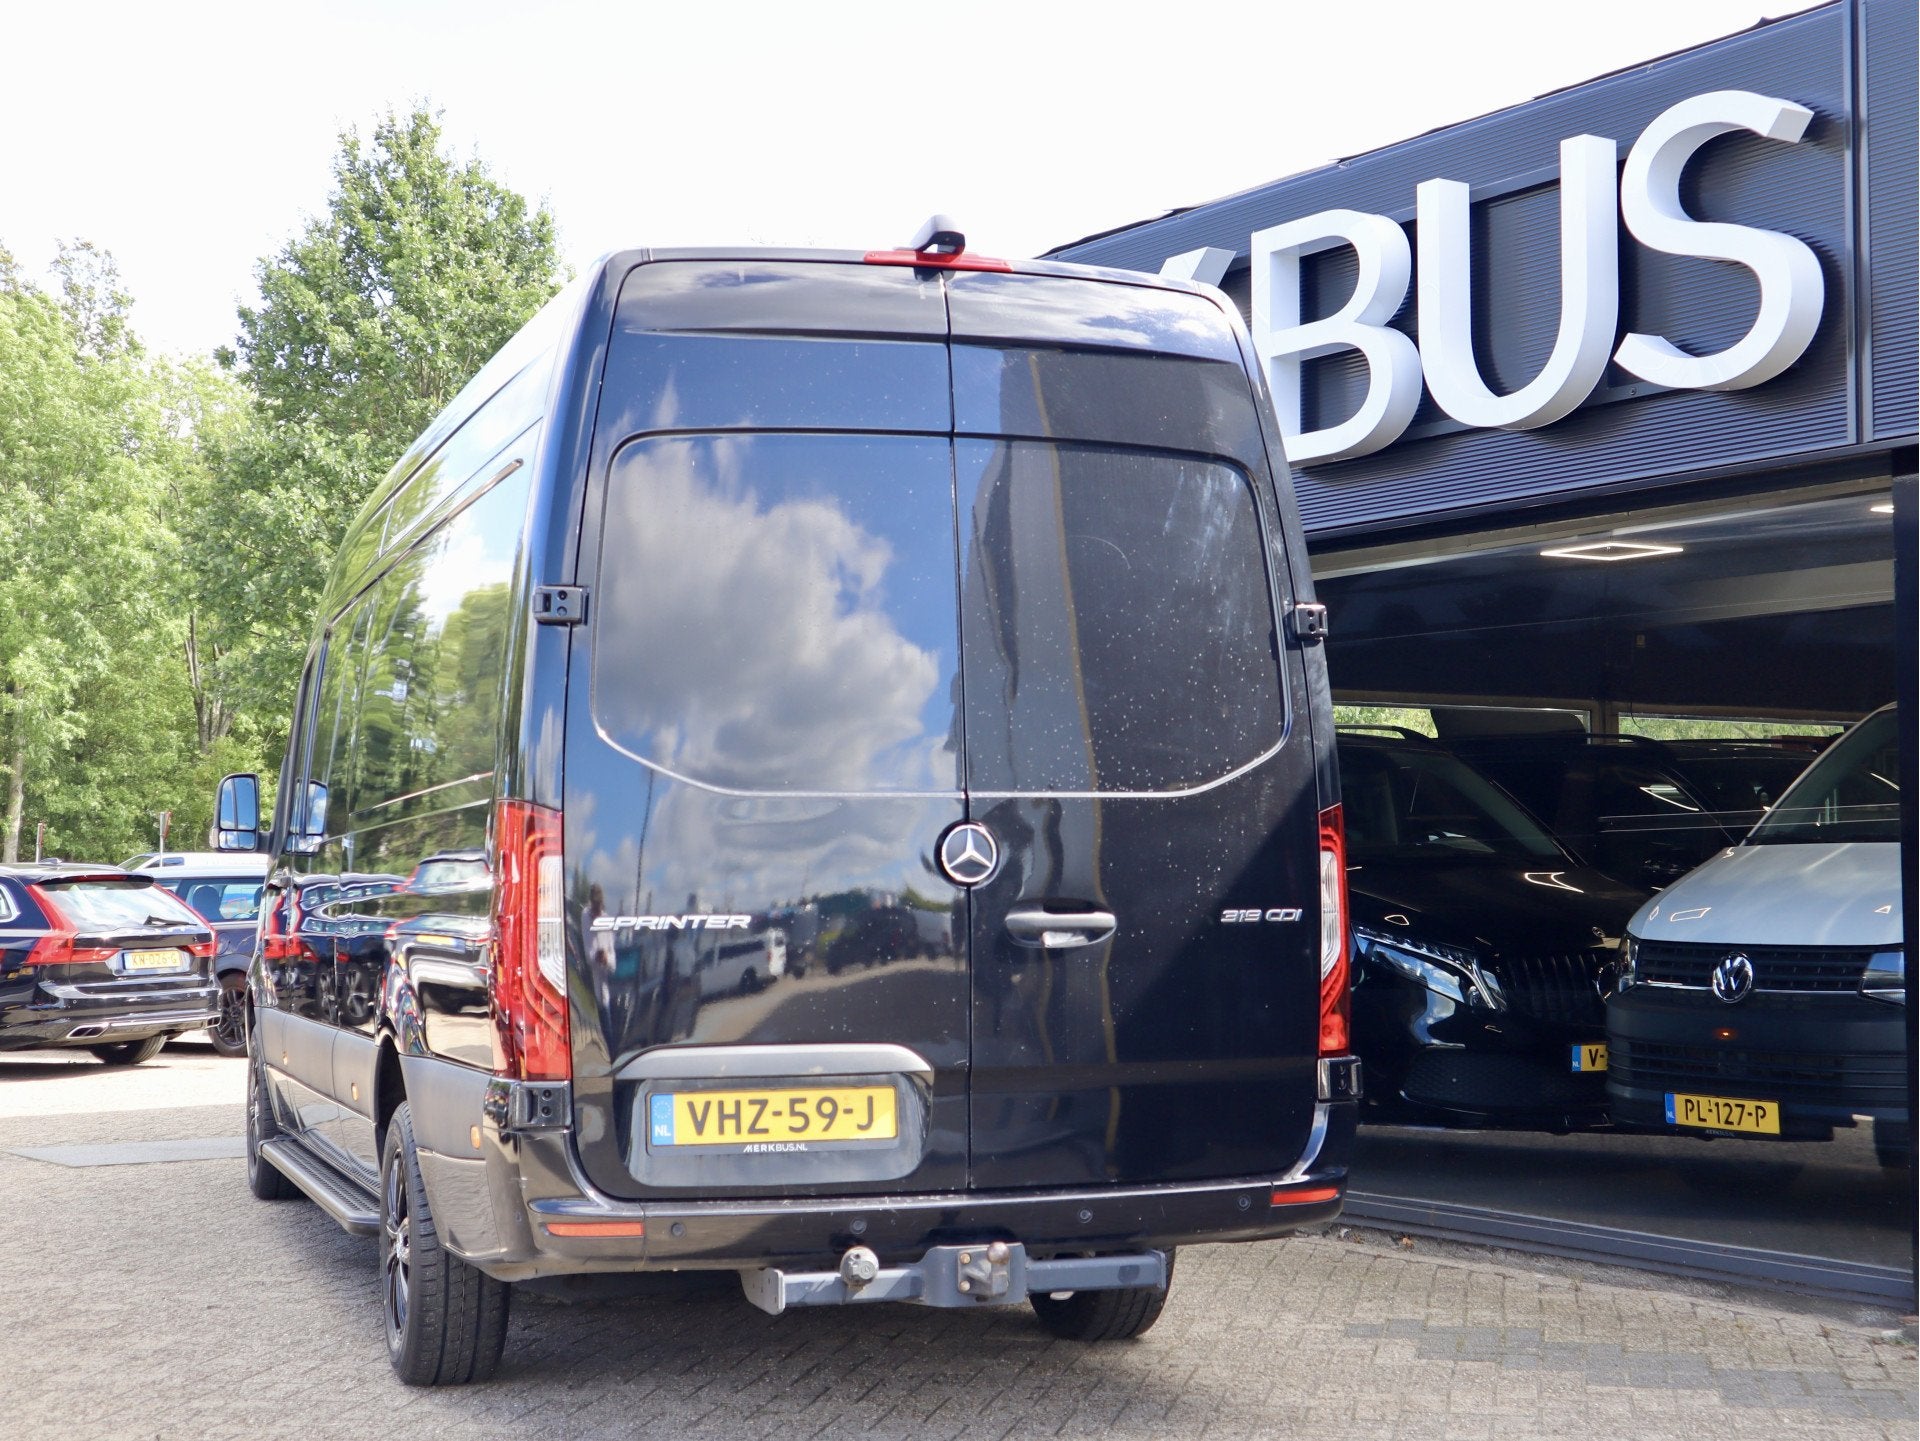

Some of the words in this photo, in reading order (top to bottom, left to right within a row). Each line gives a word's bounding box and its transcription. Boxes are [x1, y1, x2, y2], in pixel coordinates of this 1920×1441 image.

[1157, 89, 1826, 463] BUS
[590, 914, 752, 931] SPRINTER
[1221, 909, 1262, 923] 319
[1265, 908, 1303, 922] CDI
[686, 1095, 875, 1136] VHZ-59-J
[1684, 1098, 1767, 1128] PL-127-P
[654, 1125, 672, 1137] NL
[743, 1143, 808, 1153] MERKBUS.NL
